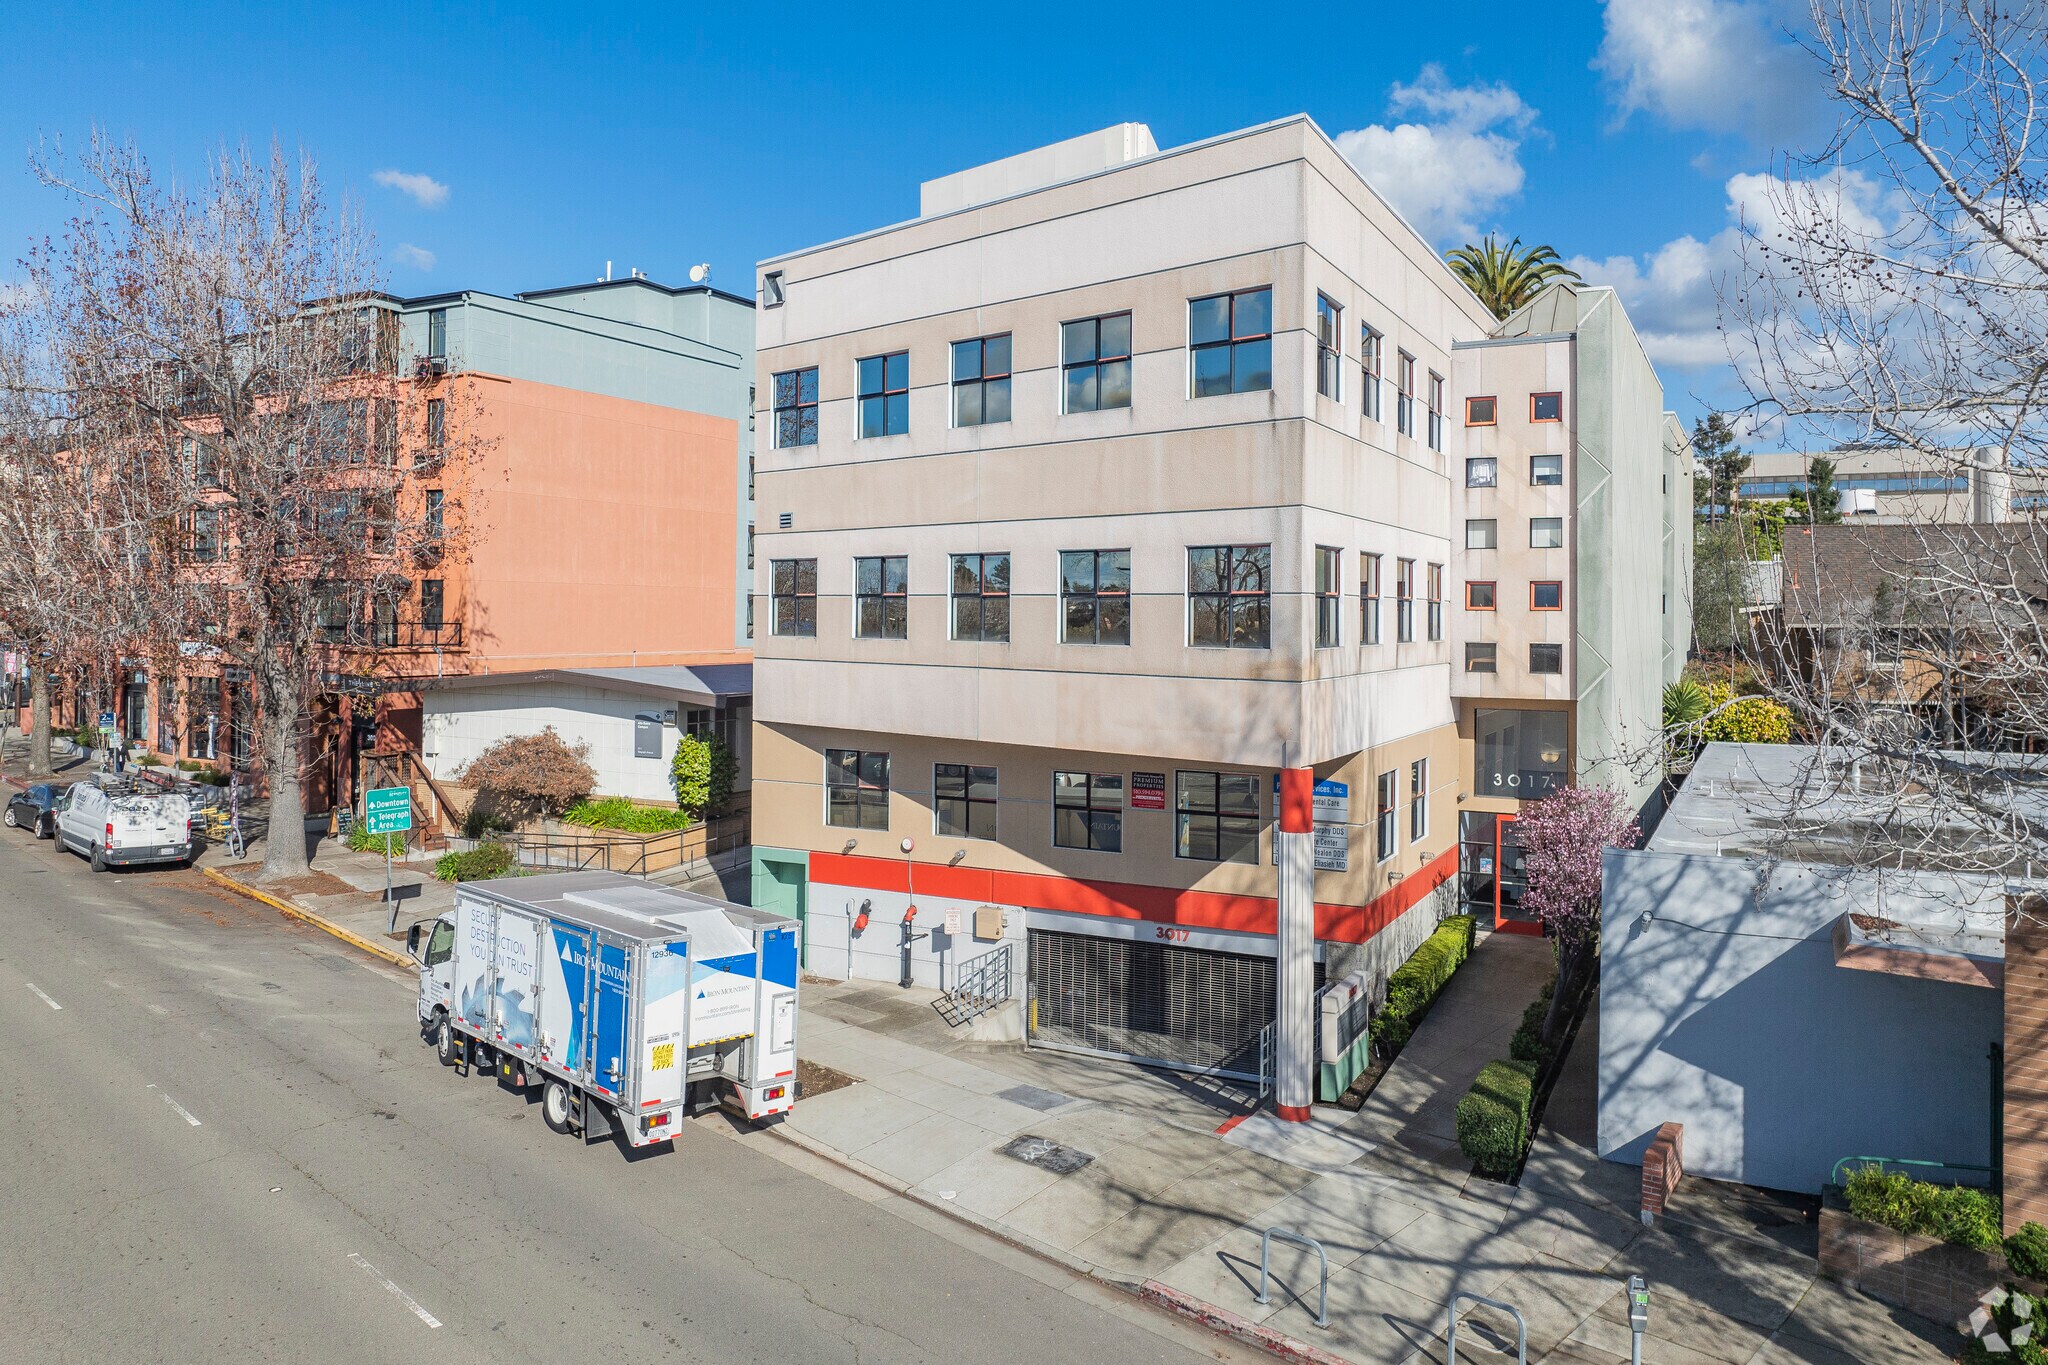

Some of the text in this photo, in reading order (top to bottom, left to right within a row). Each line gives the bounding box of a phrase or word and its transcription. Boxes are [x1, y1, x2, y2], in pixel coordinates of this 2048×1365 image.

[1493, 773, 1550, 788] 3017
[1333, 786, 1344, 794] Inc.
[376, 799, 409, 809] Downtown
[1313, 798, 1340, 807] ental Care
[378, 811, 409, 821] Telegraph
[378, 821, 394, 829] Area
[1332, 827, 1345, 835] DDS
[1321, 839, 1338, 847] Center
[1333, 850, 1345, 858] DDS
[471, 908, 497, 928] SECUR
[1156, 926, 1190, 942] 3017
[470, 926, 526, 957] DESTRCTION
[470, 943, 487, 960] YOU
[506, 956, 533, 977] TRUST
[573, 950, 588, 969] IRO
[720, 985, 750, 995] MOUNTAIN
